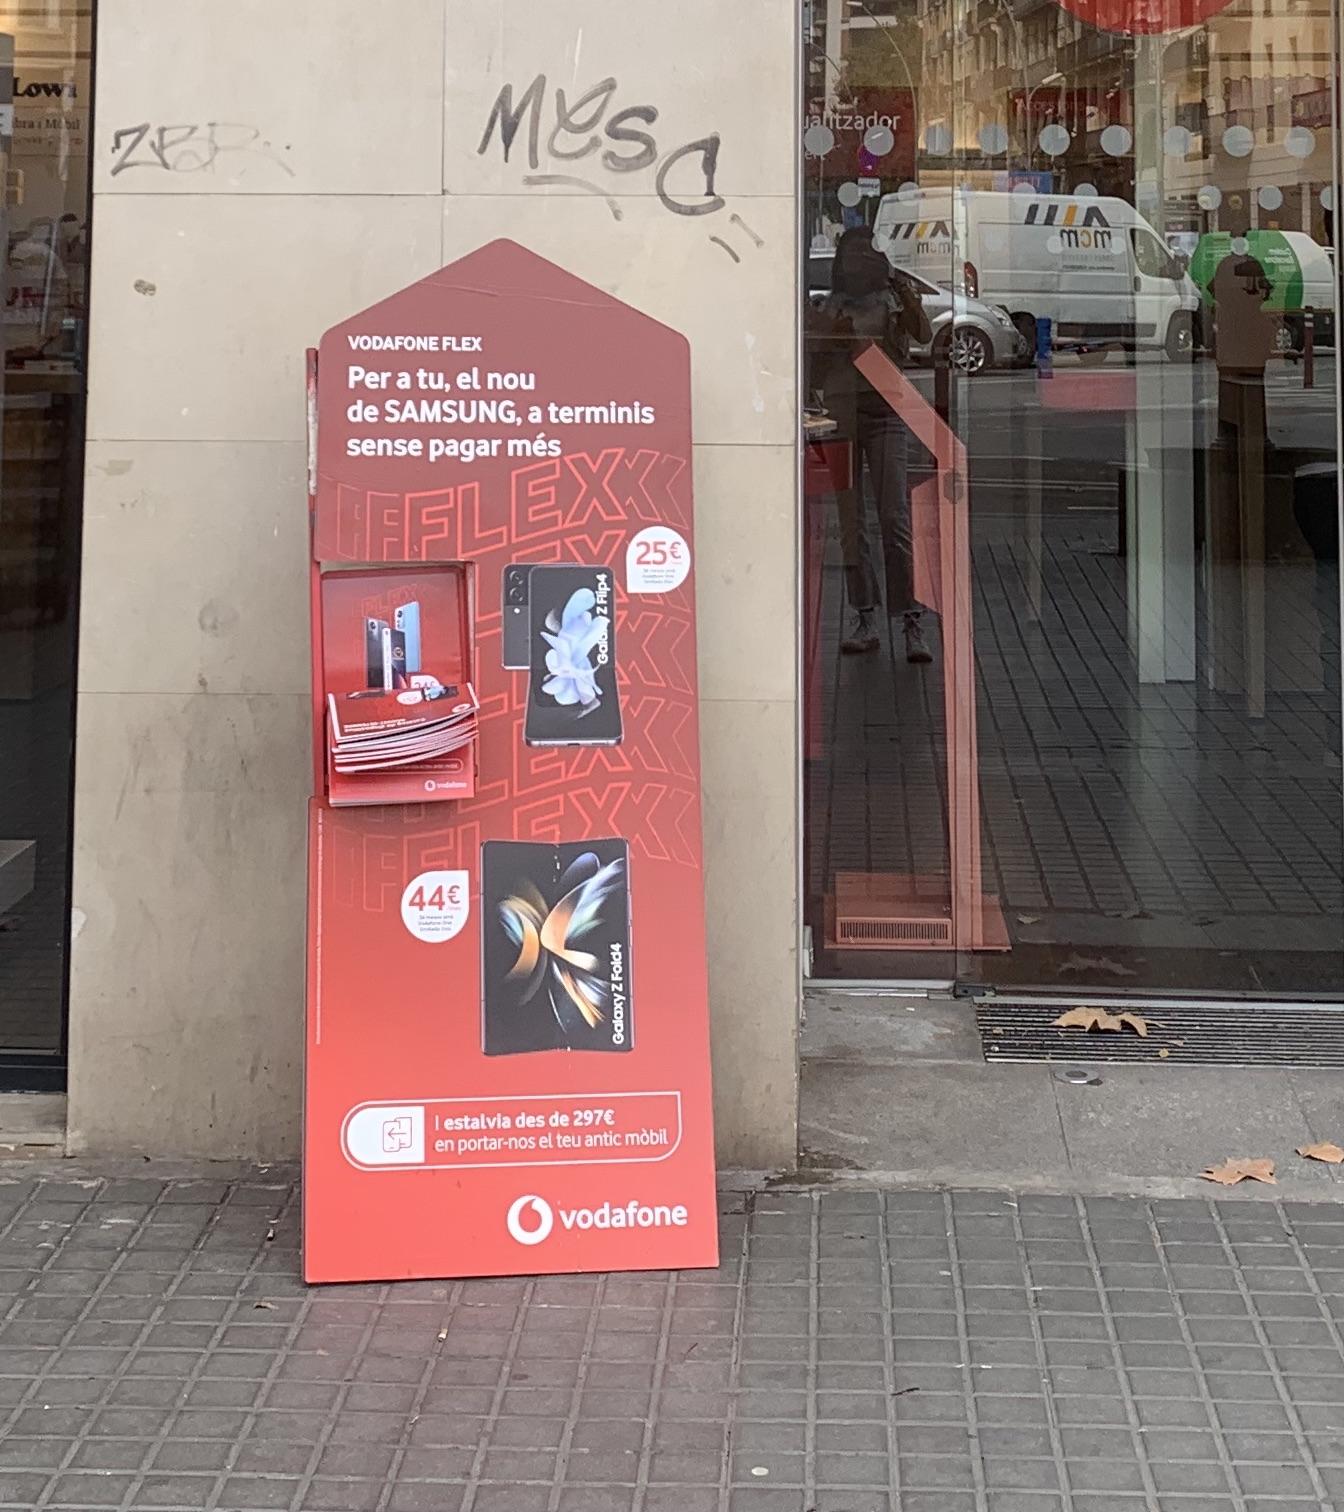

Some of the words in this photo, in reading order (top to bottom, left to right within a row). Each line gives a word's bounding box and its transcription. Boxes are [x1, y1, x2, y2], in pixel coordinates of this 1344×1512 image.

[348, 335, 439, 351] VODAFONE
[442, 336, 483, 352] FLEX
[348, 366, 391, 390] Per
[396, 371, 409, 390] a
[417, 368, 451, 392] tu,
[456, 367, 481, 390] el
[487, 372, 535, 390] nou
[347, 400, 379, 423] de
[384, 400, 522, 426] SAMSUNG,
[528, 407, 542, 424] a
[549, 401, 655, 424] terminis
[347, 439, 423, 457] sense
[429, 439, 504, 462] pagar
[507, 432, 562, 457] més
[636, 541, 682, 565] 25€
[596, 573, 612, 604] Flip4
[408, 885, 460, 911] 44€
[610, 943, 623, 981] Fold4
[612, 982, 623, 992] Z
[613, 993, 627, 1045] Galaxy
[443, 1112, 511, 1131] estalvia
[515, 1111, 544, 1129] des
[549, 1110, 569, 1128] de
[573, 1109, 615, 1127] 297€
[435, 1139, 454, 1152] en
[457, 1134, 535, 1155] portar-nos
[539, 1133, 553, 1149] el
[556, 1134, 581, 1149] teu
[585, 1131, 622, 1148] antic
[625, 1127, 668, 1146] mòbil
[560, 1200, 688, 1231] vodafone
